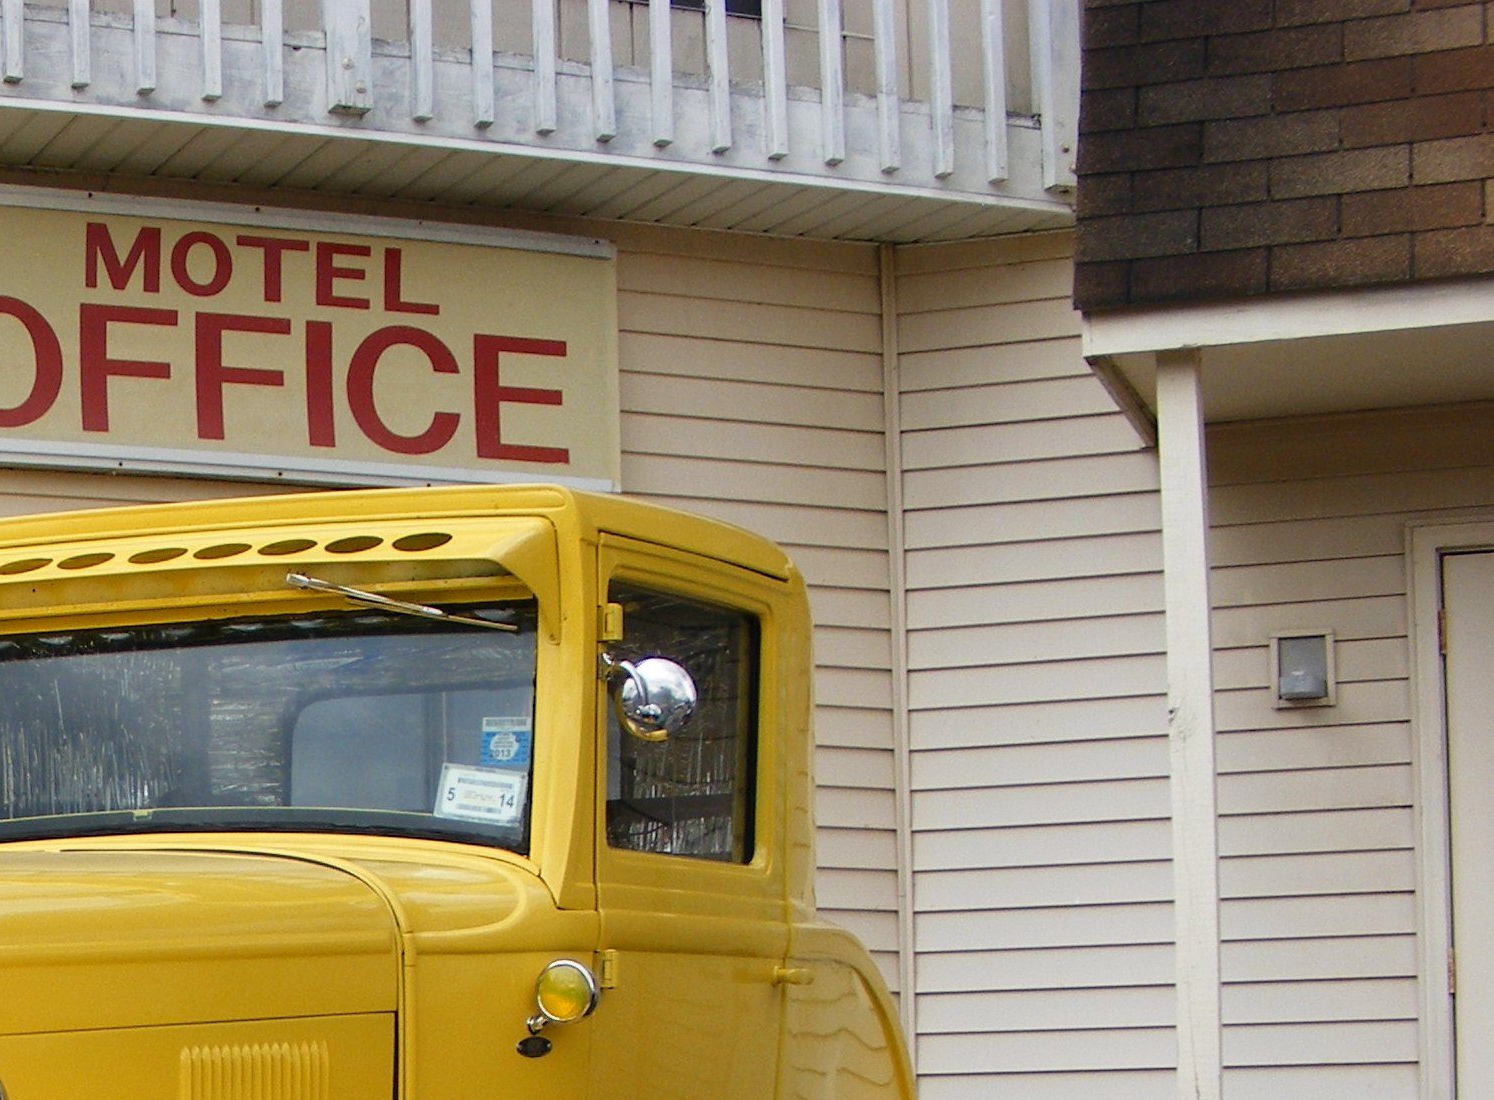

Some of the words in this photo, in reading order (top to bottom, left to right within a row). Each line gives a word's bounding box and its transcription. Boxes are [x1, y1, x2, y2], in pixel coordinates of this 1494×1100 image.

[85, 221, 440, 316] MOTEL
[446, 786, 456, 801] 5
[499, 793, 515, 809] 14
